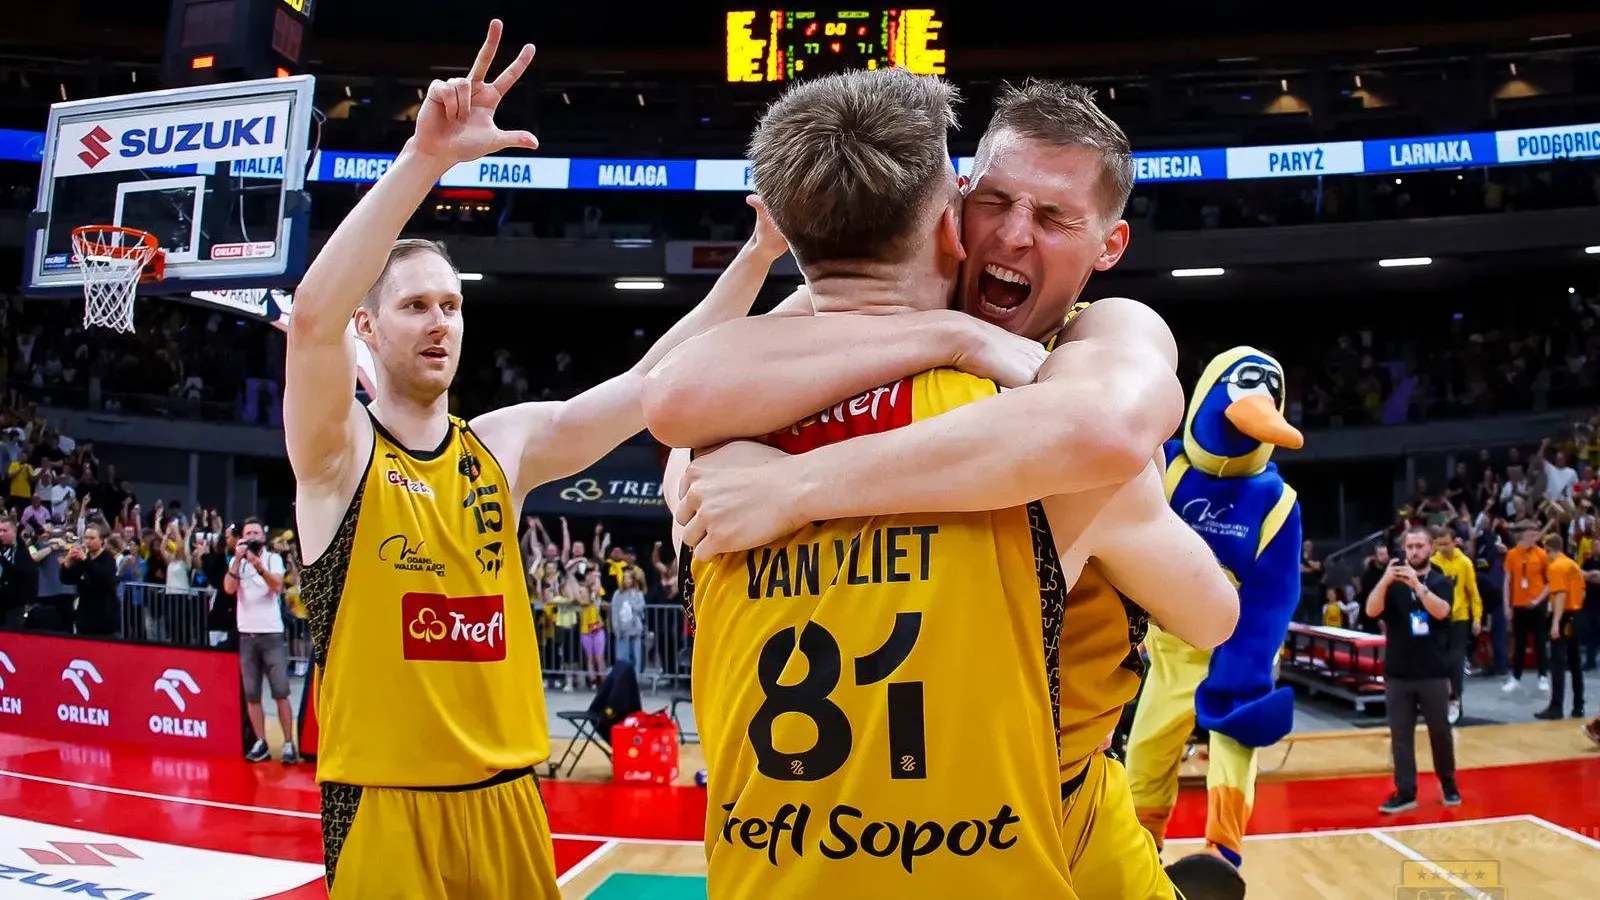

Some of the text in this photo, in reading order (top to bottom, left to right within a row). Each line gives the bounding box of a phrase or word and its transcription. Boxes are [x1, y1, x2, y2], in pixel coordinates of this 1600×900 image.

[119, 116, 276, 158] SUZUKI
[234, 156, 283, 174] MALTA
[1269, 146, 1325, 172] PARYŻ
[1390, 140, 1473, 167] LARNAKA
[333, 157, 394, 180] BARCE
[479, 163, 531, 184] PRAGA
[598, 164, 667, 187] MALAGA
[747, 542, 820, 599] VAN
[448, 611, 503, 648] Trefl
[747, 611, 928, 783] 81
[57, 703, 110, 727] ORLEN
[148, 714, 208, 739] ORLEN
[819, 803, 1022, 875] Sopot
